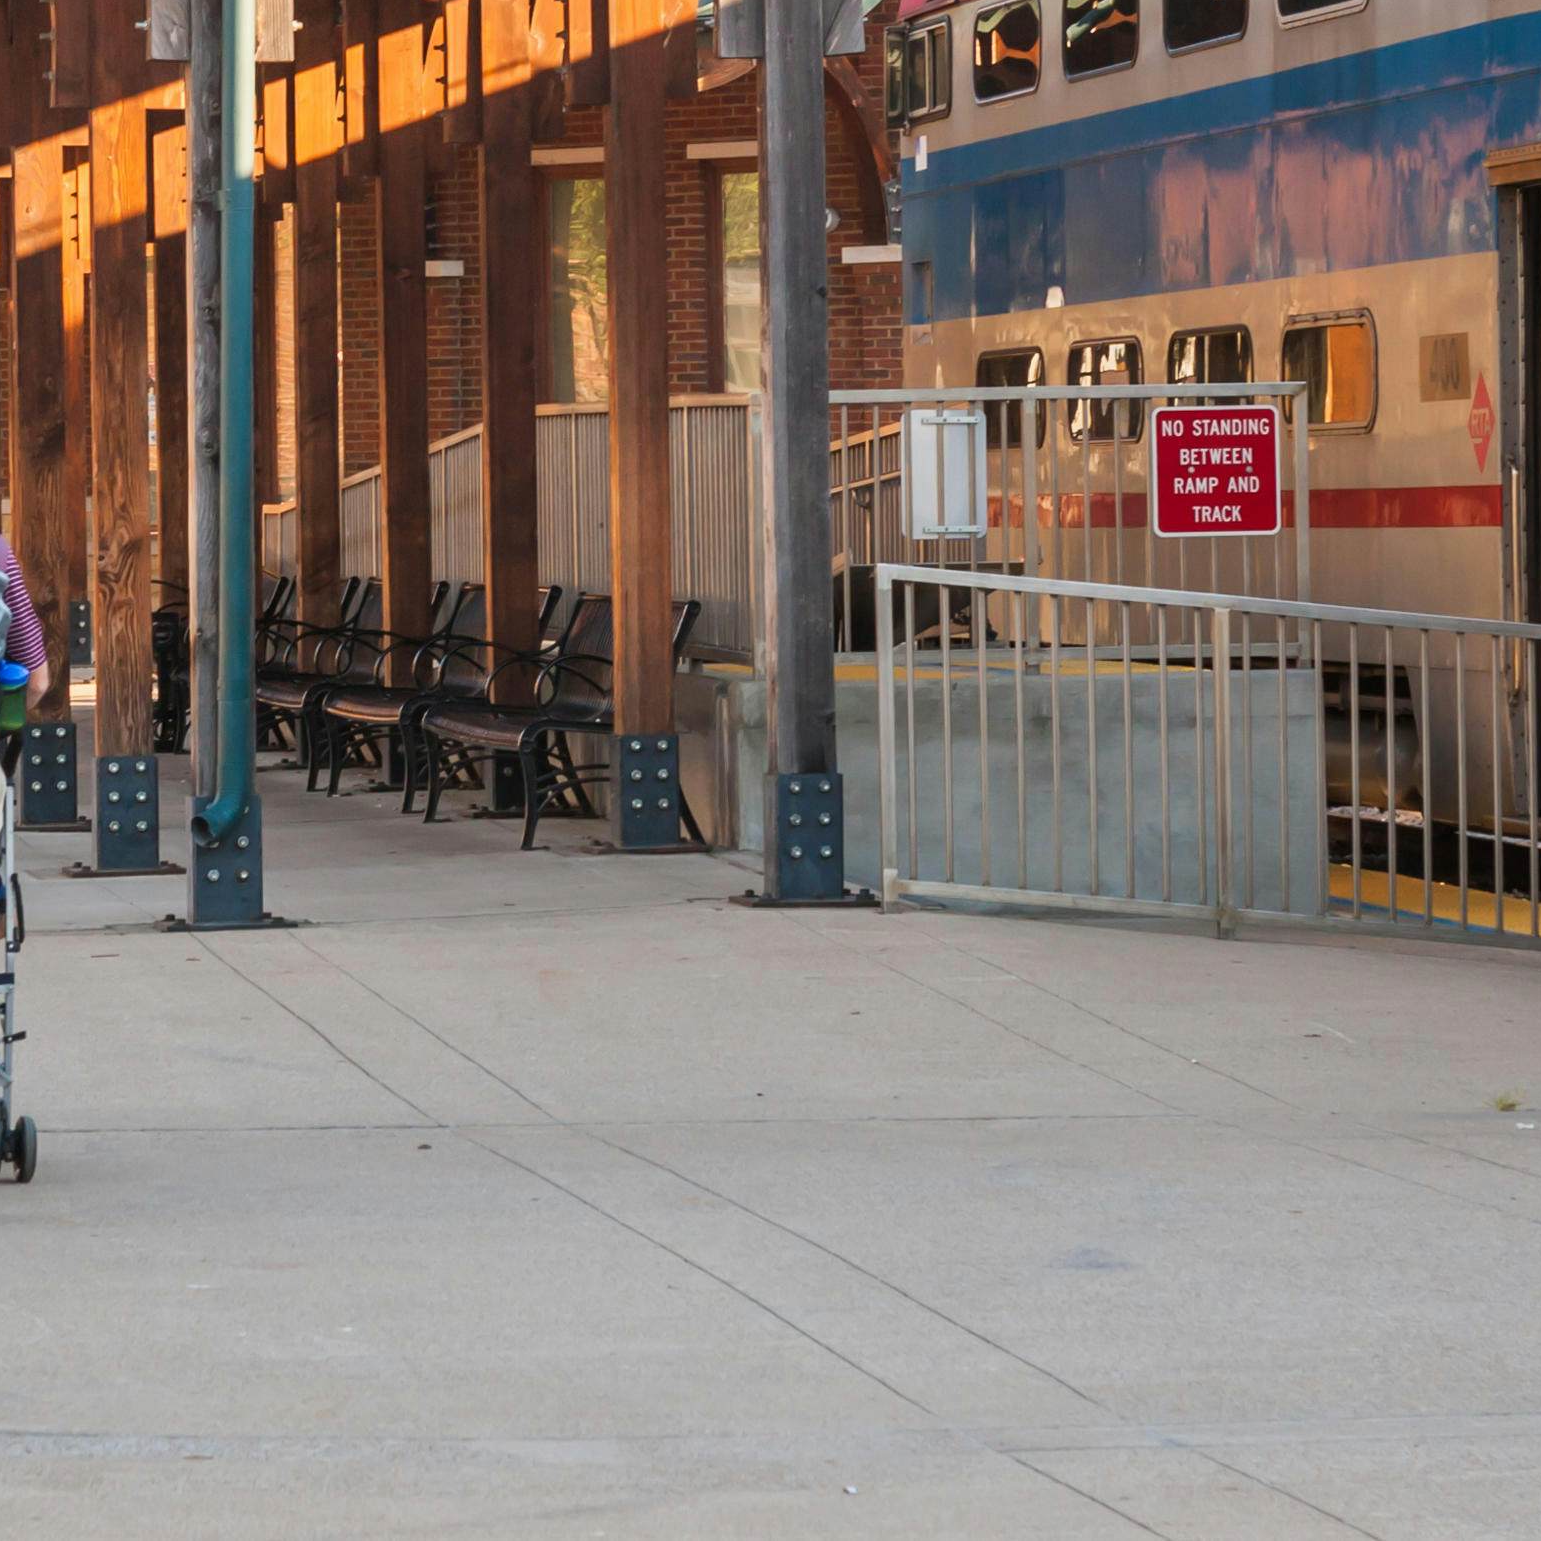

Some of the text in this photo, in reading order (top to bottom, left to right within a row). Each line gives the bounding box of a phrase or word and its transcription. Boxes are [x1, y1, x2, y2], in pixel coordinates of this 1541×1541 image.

[1161, 418, 1270, 437] NO STANDING
[1179, 447, 1253, 466] BETWEEN
[1173, 475, 1260, 495] RAMP AND
[1192, 505, 1242, 523] TRACK
